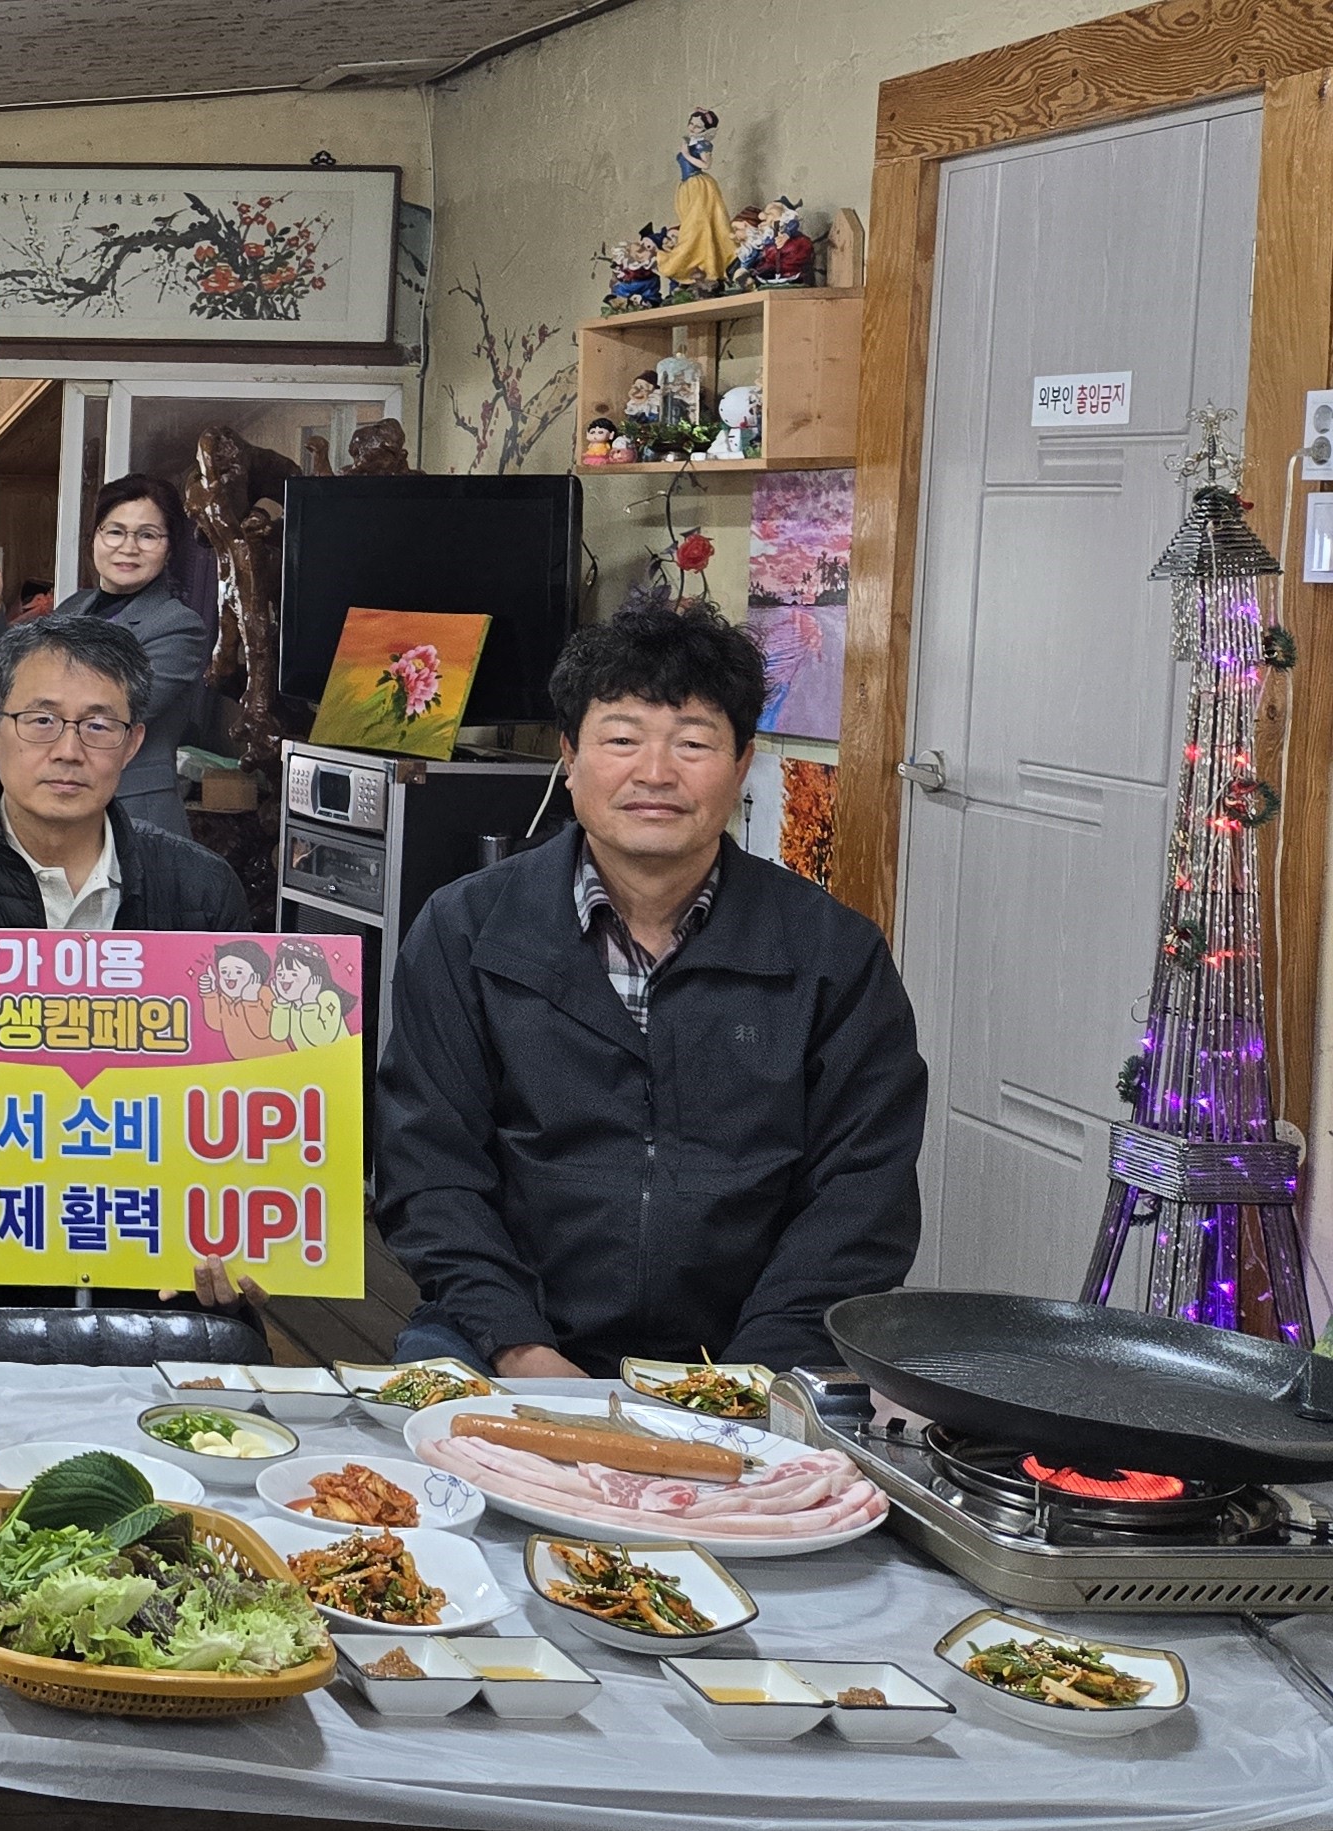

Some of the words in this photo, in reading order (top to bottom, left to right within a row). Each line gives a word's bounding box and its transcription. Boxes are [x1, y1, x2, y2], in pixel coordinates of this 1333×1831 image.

[1038, 384, 1074, 415] 외부인
[1076, 382, 1126, 415] 출입금지
[54, 938, 145, 988] 이용
[60, 1093, 161, 1165] 소비
[185, 1085, 327, 1166] UP!
[60, 1183, 161, 1256] 활력
[185, 1185, 327, 1267] UP!
